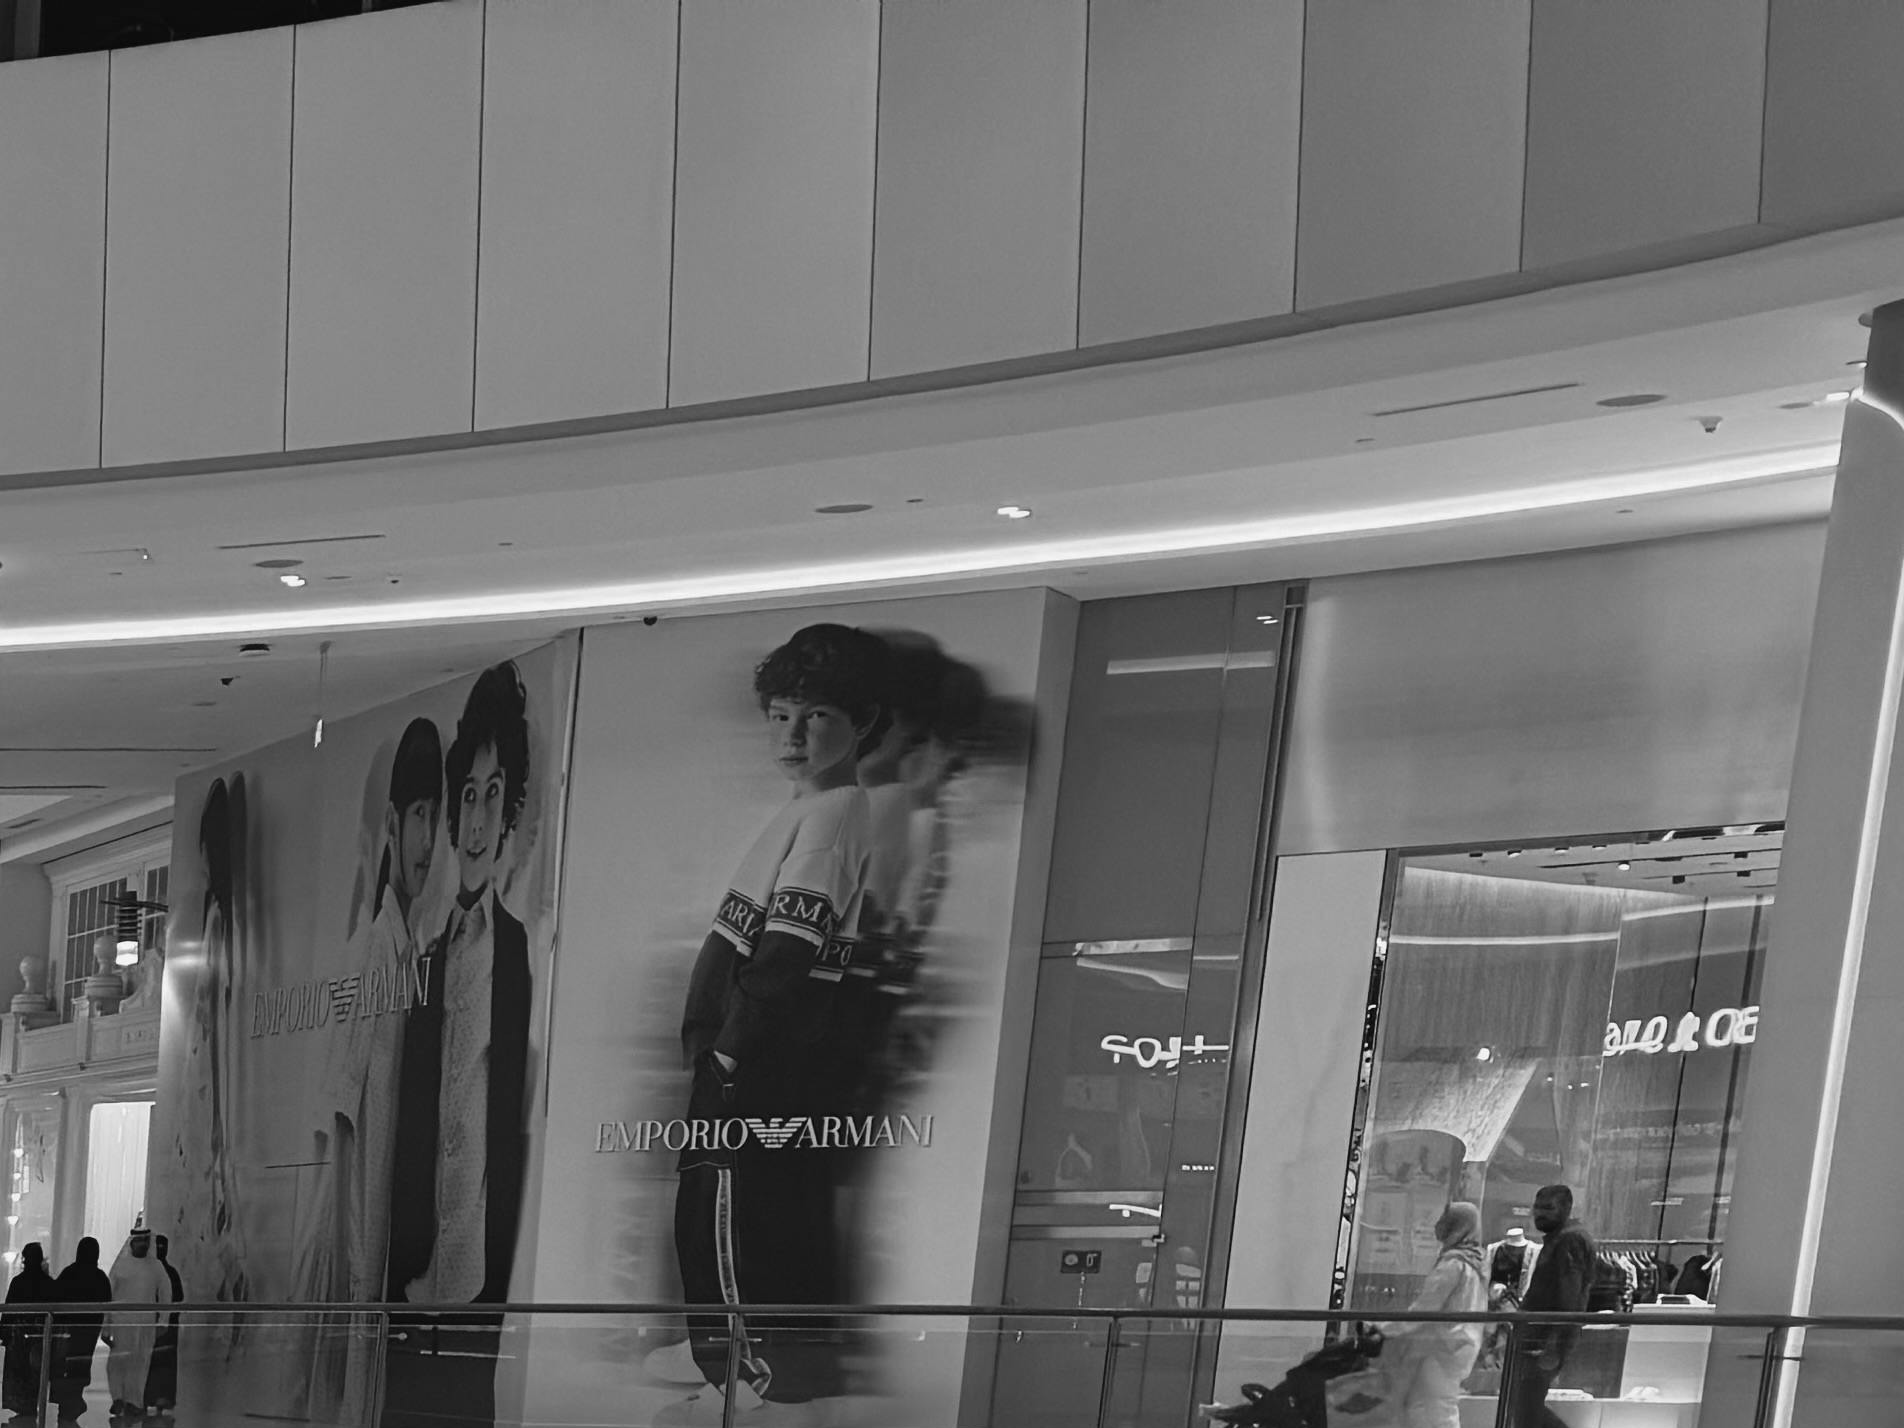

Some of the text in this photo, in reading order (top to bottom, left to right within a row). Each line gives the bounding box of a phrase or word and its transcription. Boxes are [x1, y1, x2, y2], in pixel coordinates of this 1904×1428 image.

[251, 957, 432, 1040] EMPORIO ARMANI
[594, 1115, 934, 1153] EMPORIO ARMANI
